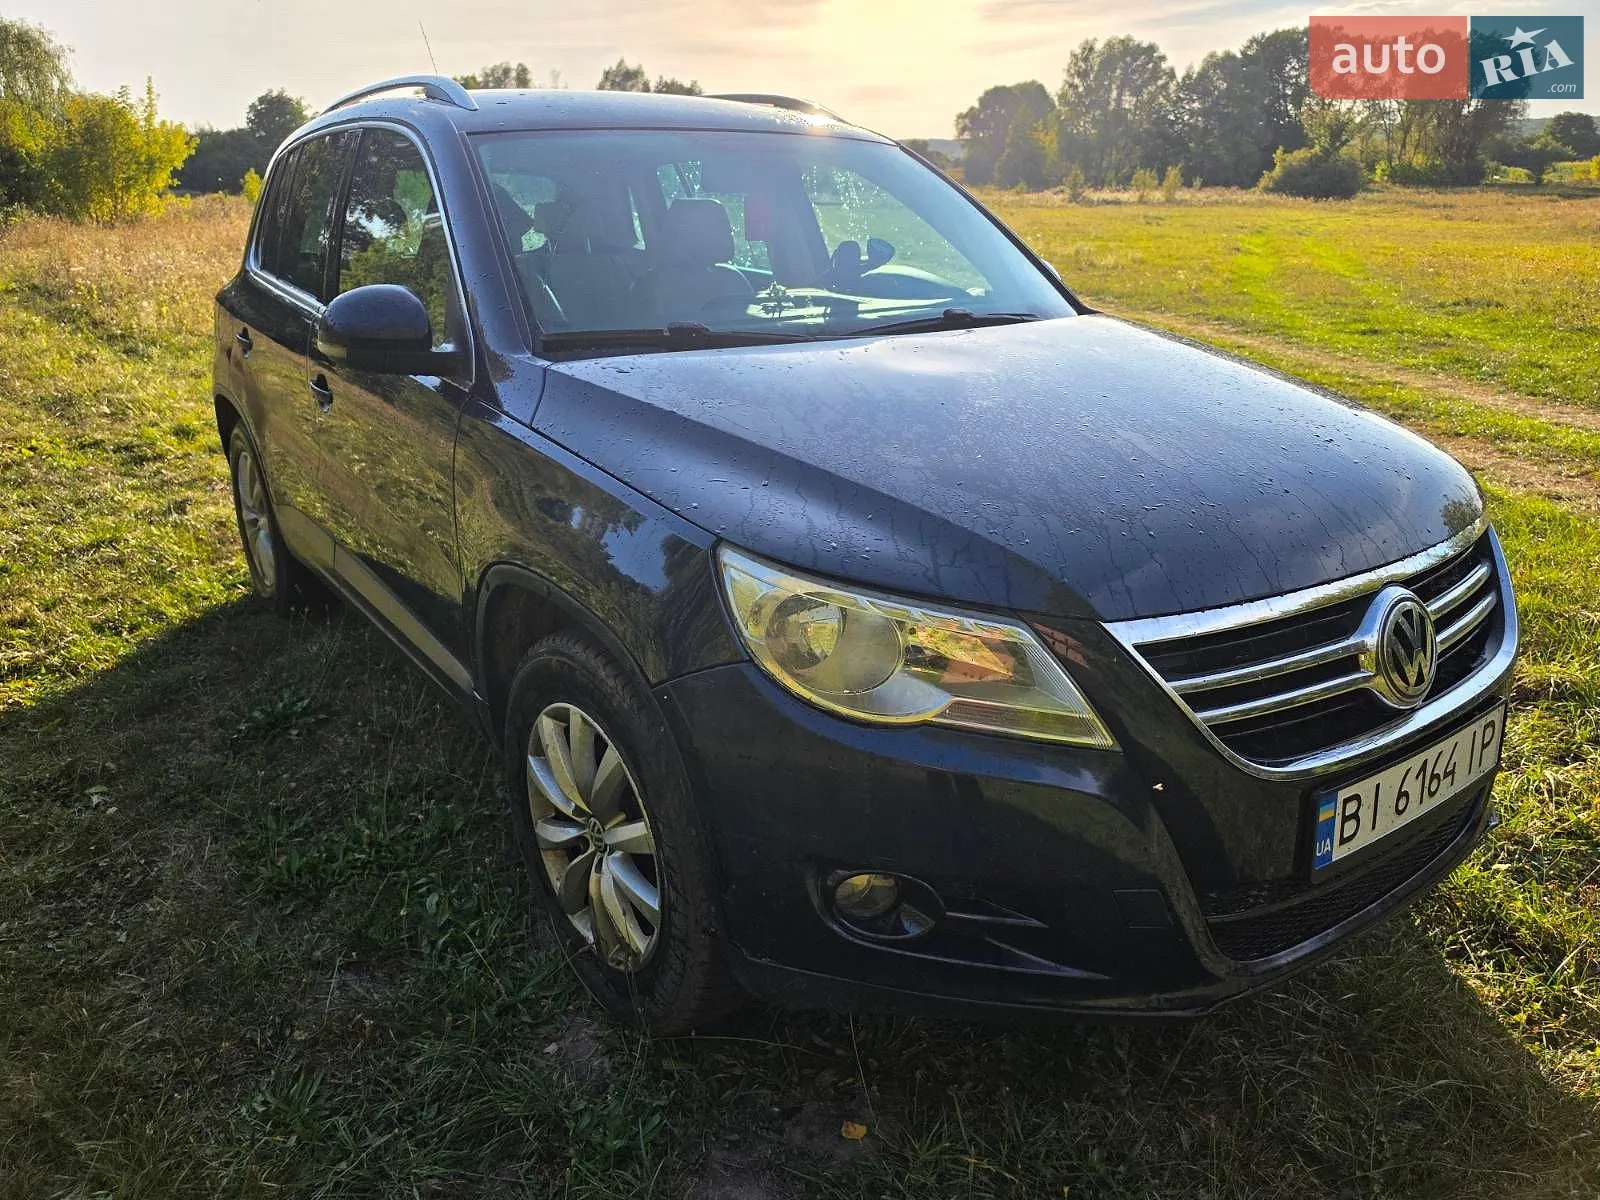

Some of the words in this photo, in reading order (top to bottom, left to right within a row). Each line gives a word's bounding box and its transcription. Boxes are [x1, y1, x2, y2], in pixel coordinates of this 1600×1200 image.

[1387, 602, 1433, 692] VW
[1338, 782, 1381, 847] BI
[1394, 741, 1458, 816] 6164
[1468, 719, 1496, 775] IP
[1316, 840, 1331, 857] UA
